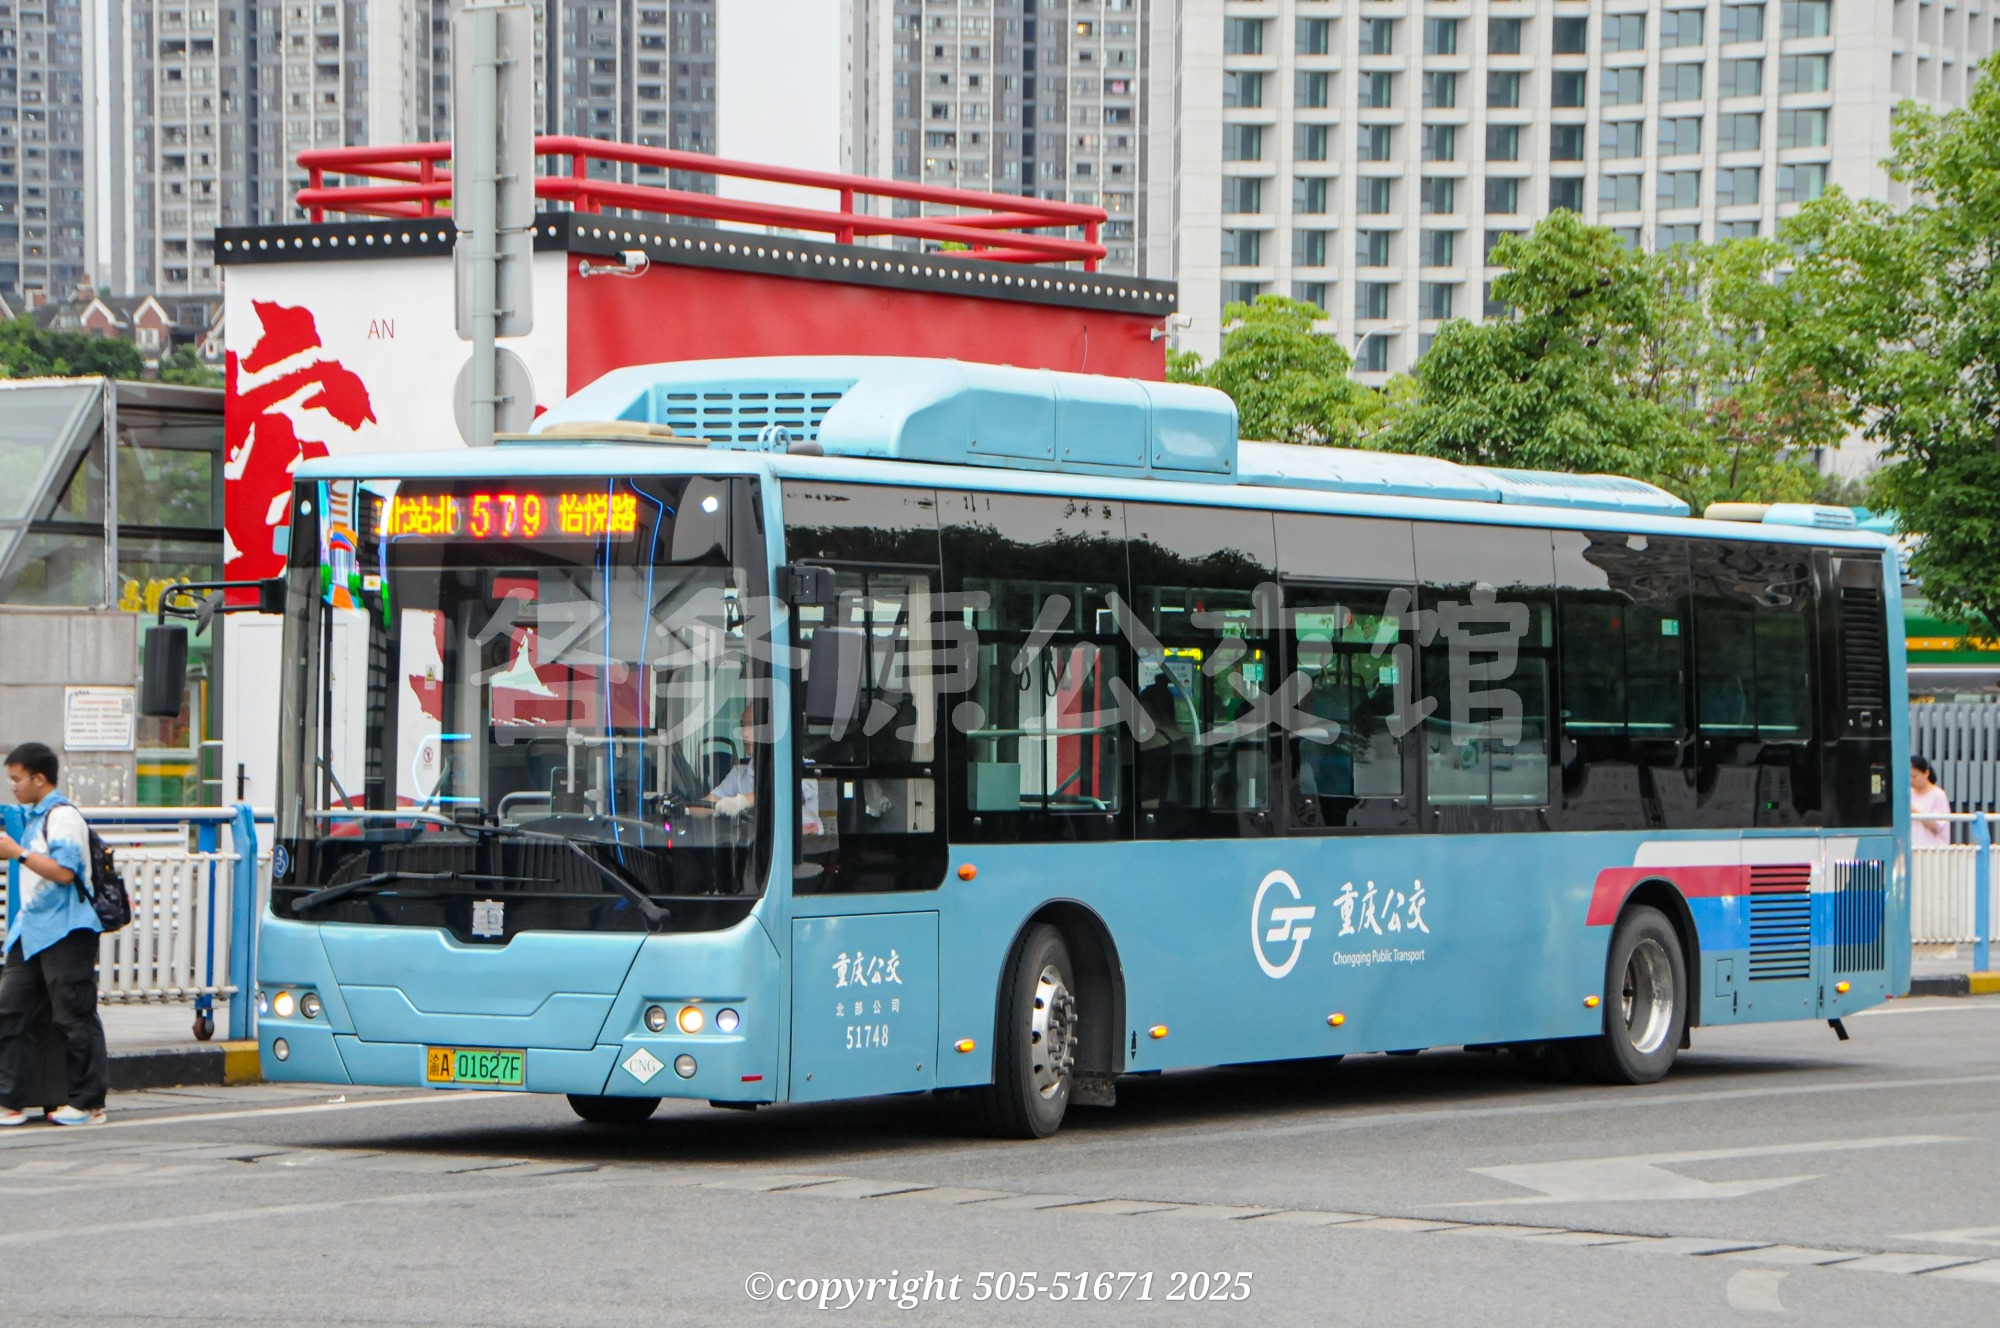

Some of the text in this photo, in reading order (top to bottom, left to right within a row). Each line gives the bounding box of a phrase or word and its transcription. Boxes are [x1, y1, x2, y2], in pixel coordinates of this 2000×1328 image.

[368, 318, 394, 340] AN
[374, 494, 636, 537] 北站北 579 怡悦路
[1333, 879, 1430, 937] 重庆公交
[832, 949, 903, 988] 重庆公交
[1333, 948, 1425, 968] Chongqing Public Transport
[836, 998, 900, 1017] 北部公司
[846, 1024, 889, 1050] 51748
[630, 1059, 656, 1073] CNG
